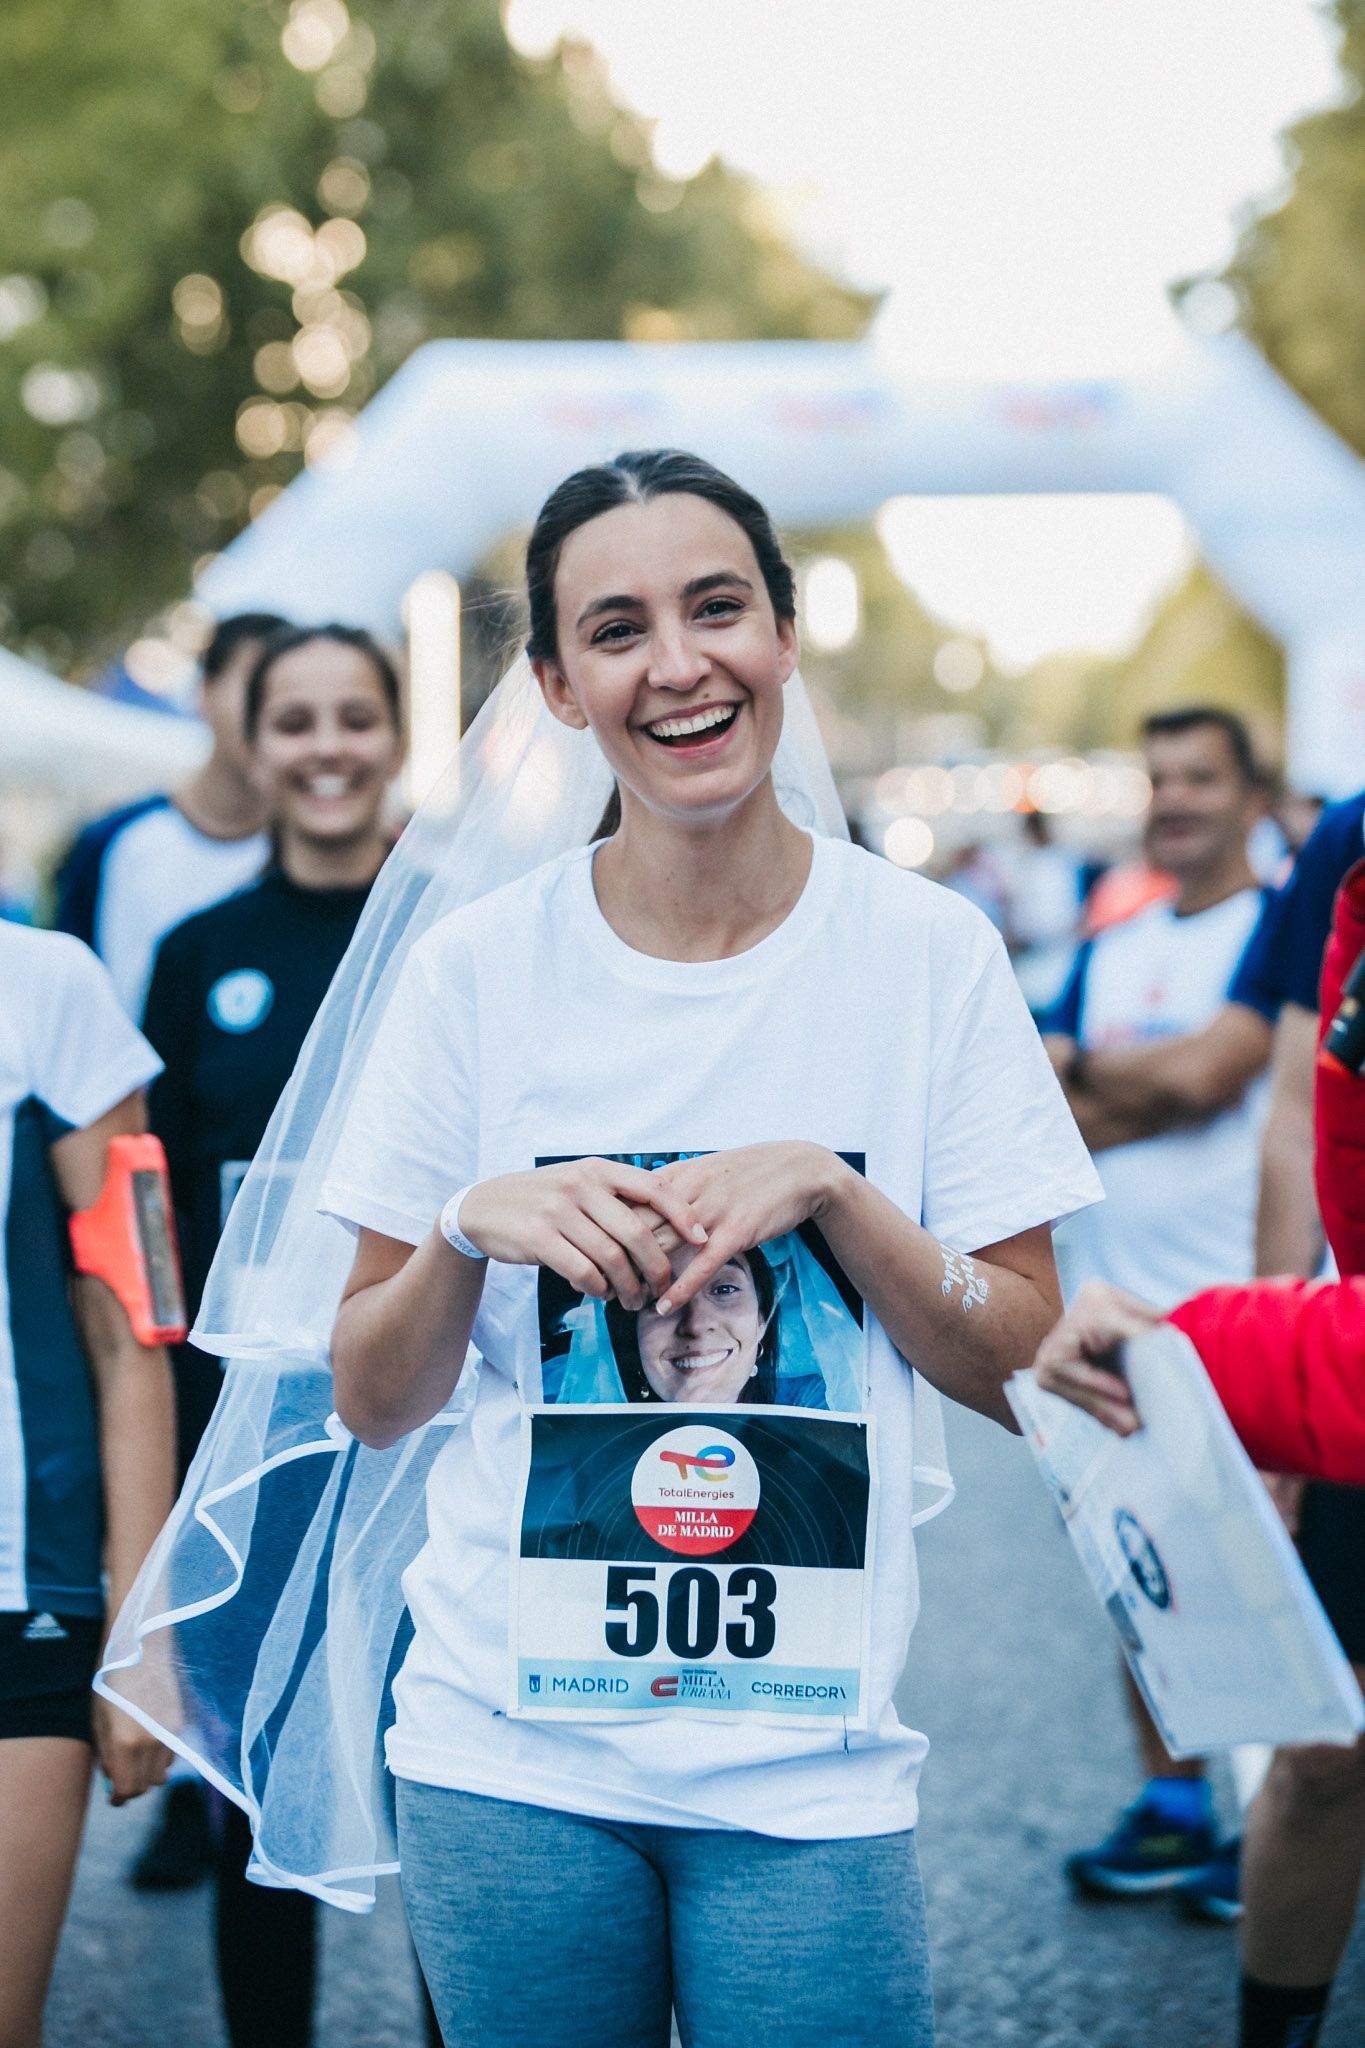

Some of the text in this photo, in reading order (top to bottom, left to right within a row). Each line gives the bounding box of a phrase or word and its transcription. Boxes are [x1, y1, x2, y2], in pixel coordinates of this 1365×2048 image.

[658, 1487, 735, 1500] TotalEnergies
[674, 1511, 719, 1524] MILLA
[658, 1525, 735, 1538] DE MADRID
[605, 1566, 777, 1659] 503
[553, 1677, 629, 1693] MADRID
[682, 1675, 726, 1687] MILLA
